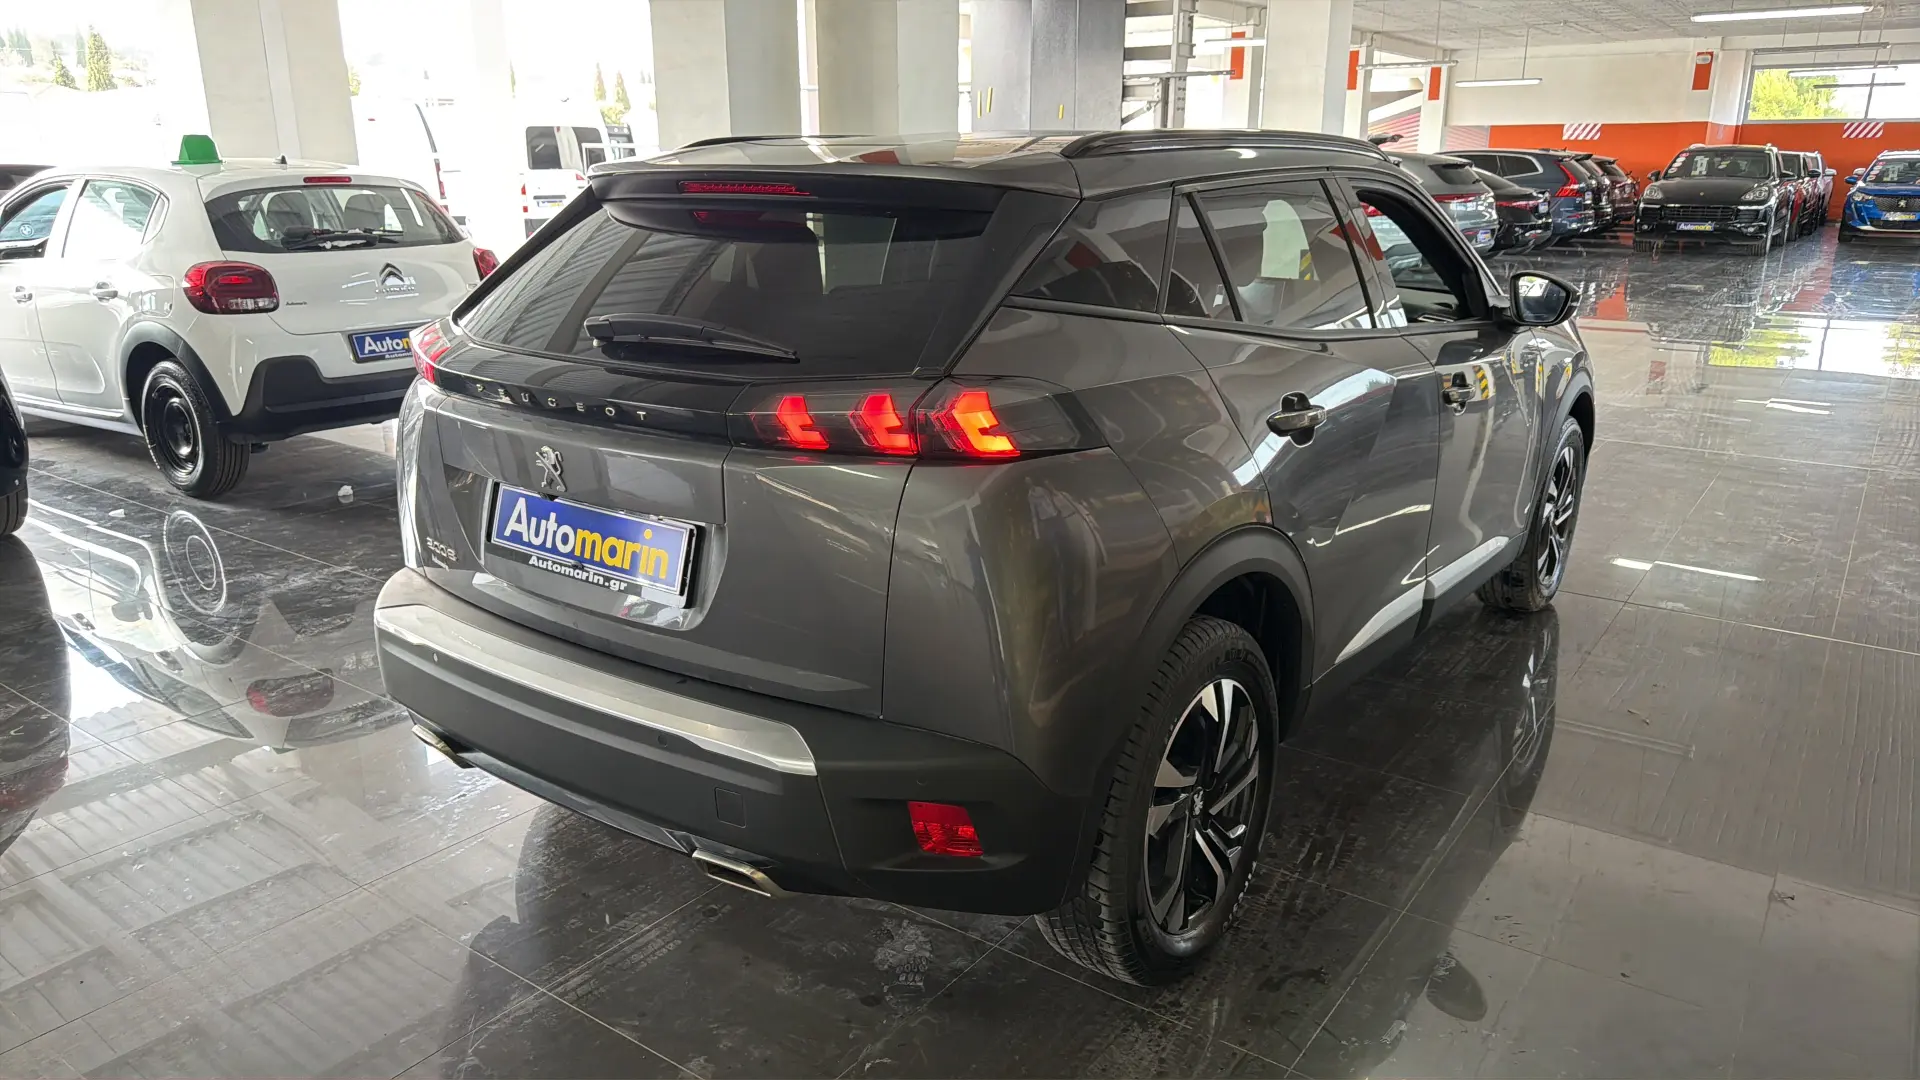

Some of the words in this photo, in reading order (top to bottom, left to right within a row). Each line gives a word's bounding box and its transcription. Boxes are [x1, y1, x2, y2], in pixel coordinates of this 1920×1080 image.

[476, 383, 646, 420] PEUGEOT
[504, 497, 669, 579] Automarin
[529, 555, 627, 591] Automarin.gr
